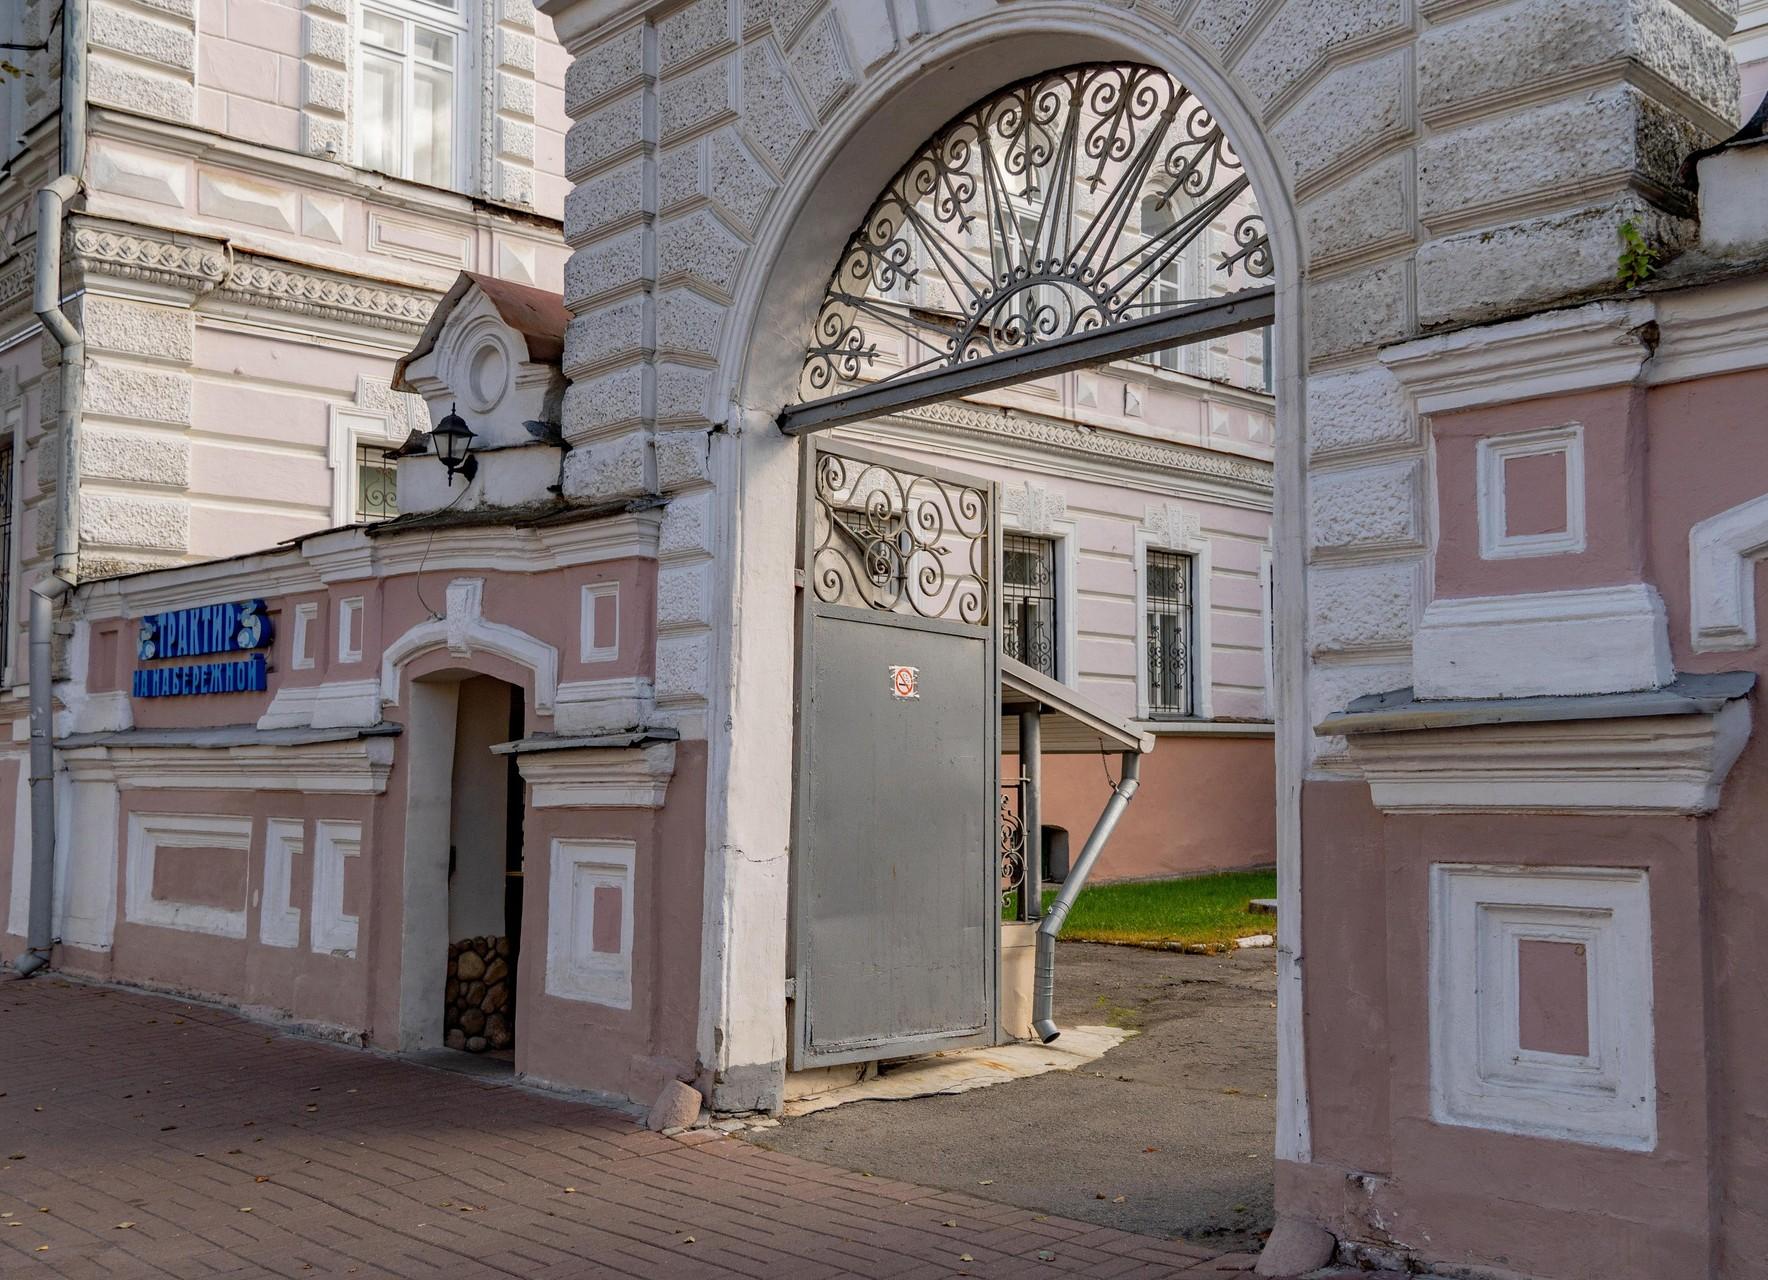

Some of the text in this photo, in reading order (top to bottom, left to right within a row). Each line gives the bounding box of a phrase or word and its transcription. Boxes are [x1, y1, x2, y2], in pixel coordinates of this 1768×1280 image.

[158, 603, 235, 658] ТРАКТИР
[133, 655, 257, 697] НА НАБЕРЕЖНОЙ
